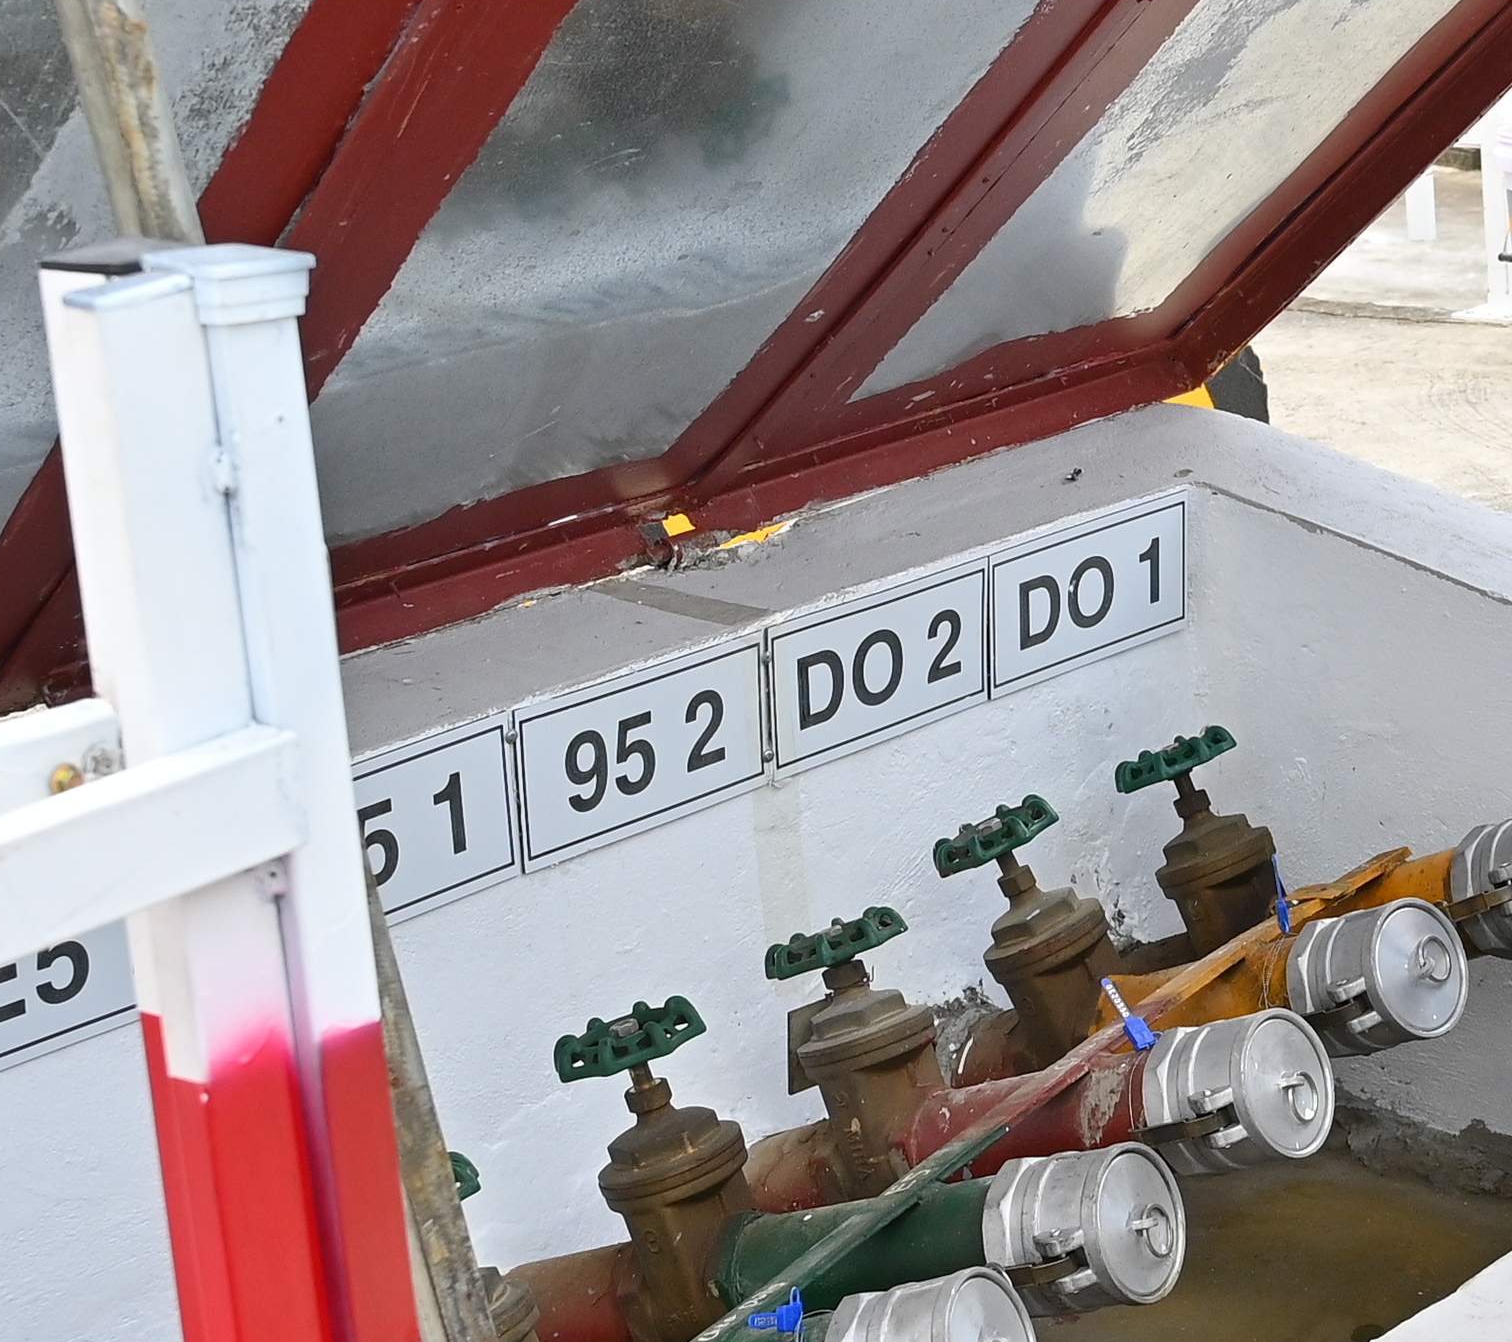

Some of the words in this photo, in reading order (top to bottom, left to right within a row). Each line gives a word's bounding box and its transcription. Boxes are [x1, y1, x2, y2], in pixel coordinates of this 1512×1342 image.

[1019, 555, 1114, 651] DO
[1138, 536, 1160, 605] 1
[796, 629, 903, 730] DO
[926, 609, 962, 685] 2
[564, 710, 656, 813] 95
[684, 689, 726, 773] 2
[356, 797, 399, 888] 5
[432, 771, 468, 855] 1
